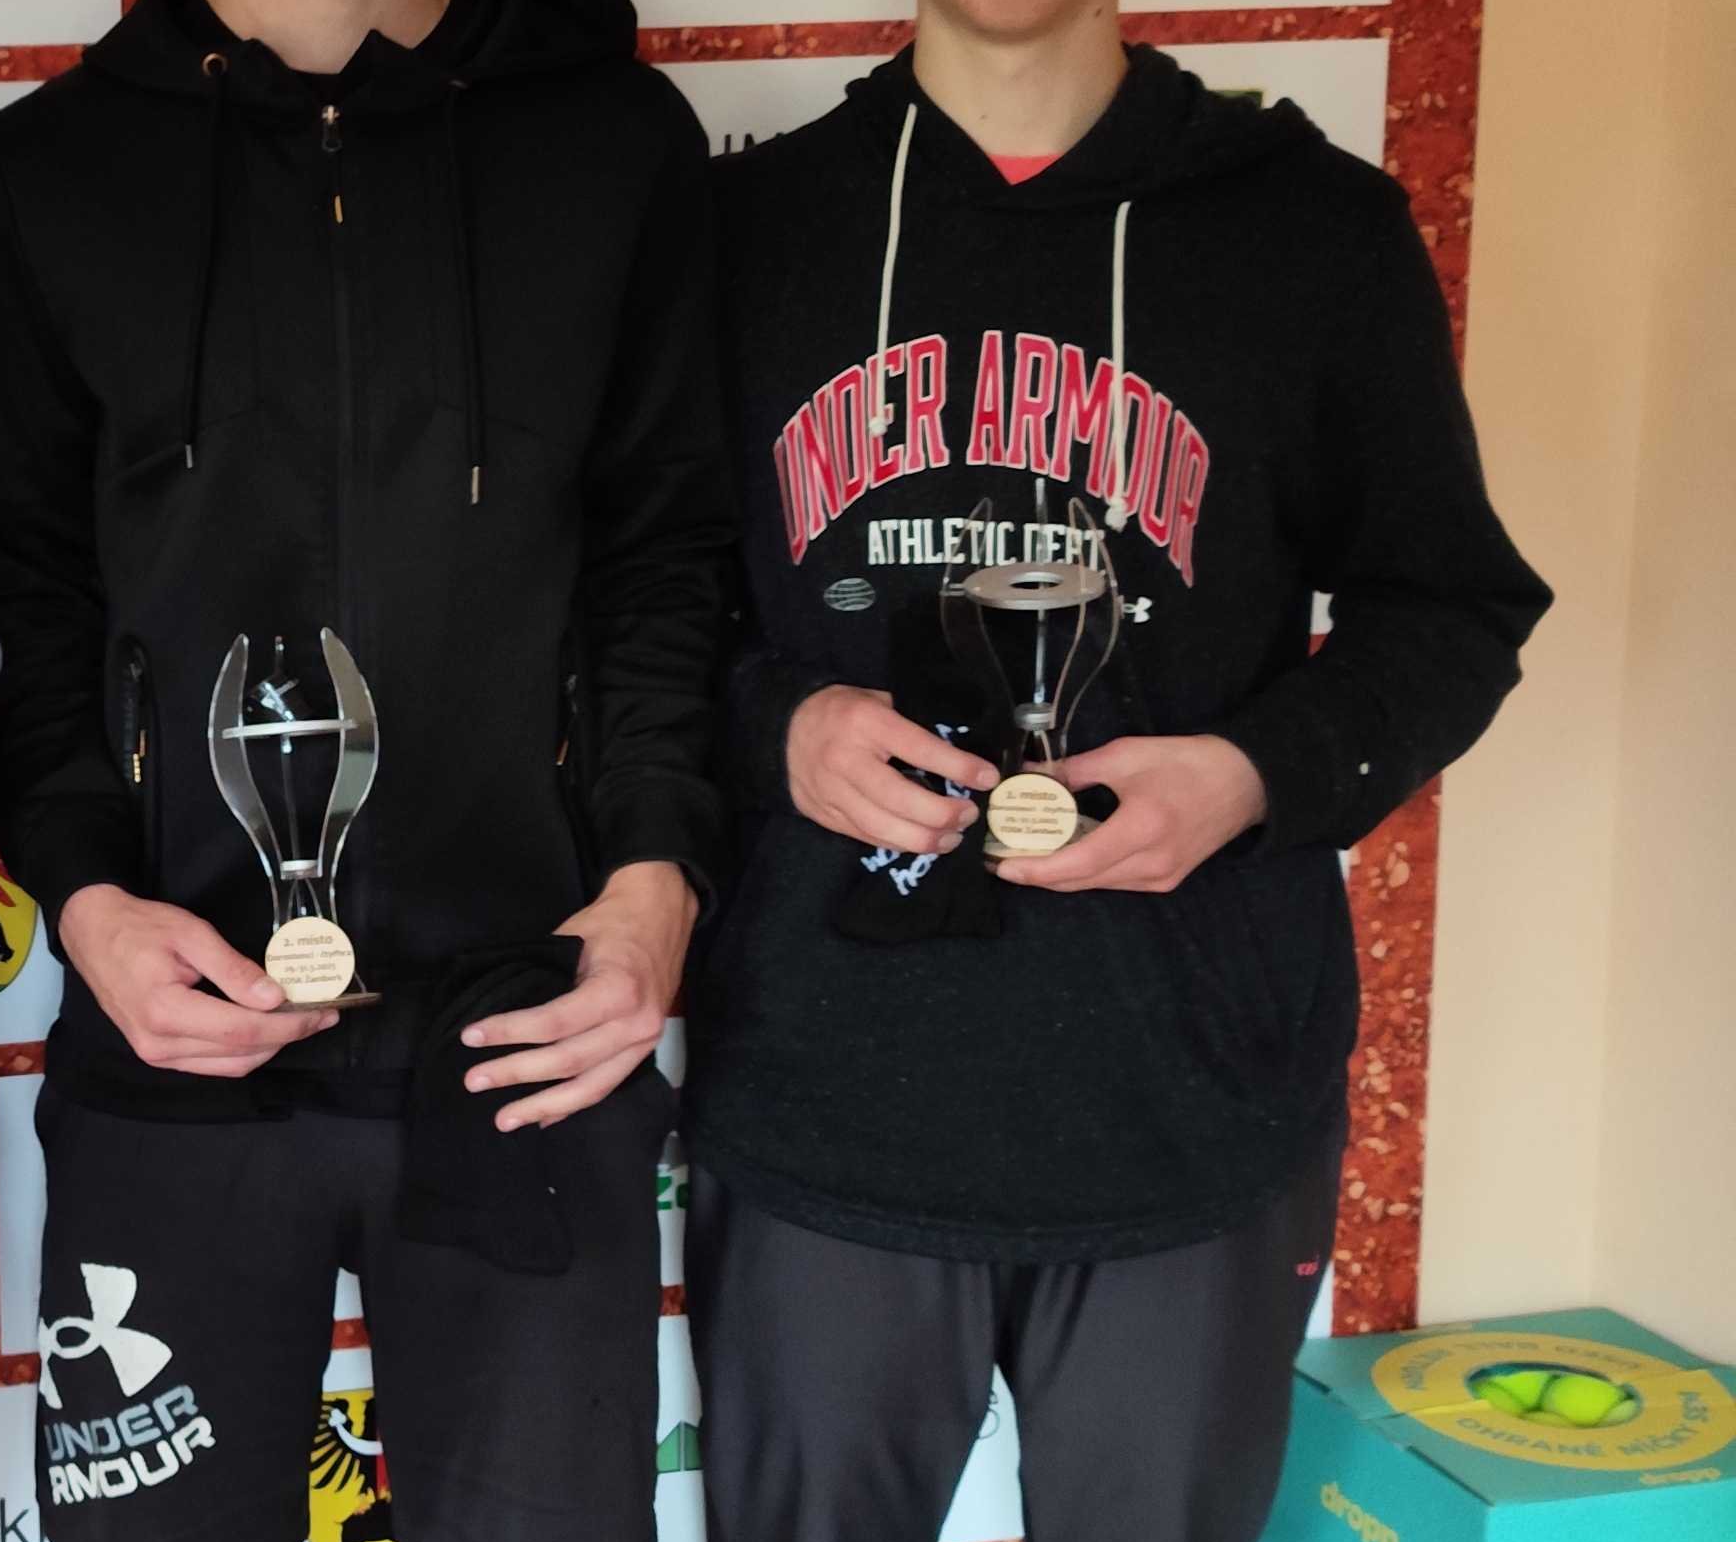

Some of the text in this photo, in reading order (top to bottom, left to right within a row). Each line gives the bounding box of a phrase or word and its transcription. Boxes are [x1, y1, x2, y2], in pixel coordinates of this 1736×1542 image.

[773, 329, 1210, 588] UNDER ARMOUR
[867, 517, 1016, 566] ATHLETIC
[44, 1384, 199, 1461] UNDER
[48, 1415, 217, 1506] RMOUR
